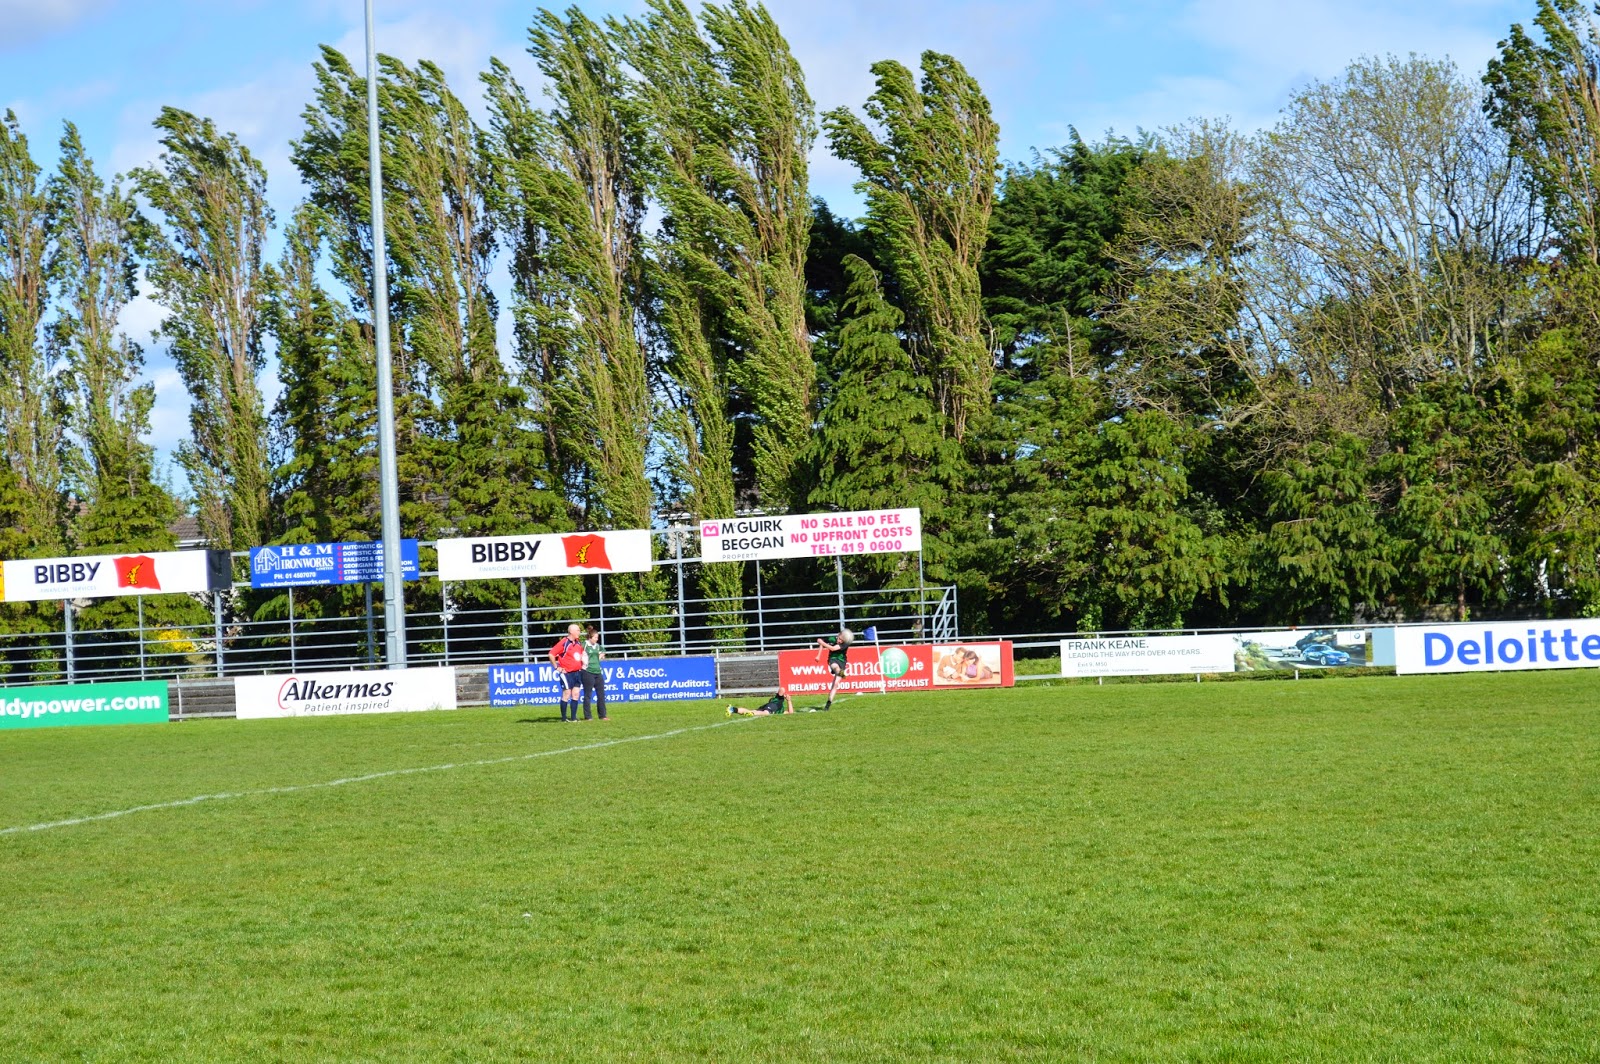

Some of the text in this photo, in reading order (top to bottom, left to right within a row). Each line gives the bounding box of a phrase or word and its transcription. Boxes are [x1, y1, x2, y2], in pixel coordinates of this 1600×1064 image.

[801, 514, 900, 529] NO SALE NO FEE
[791, 526, 913, 543] NO UPFRONT COSTS
[722, 536, 784, 551] BEGGAN
[811, 544, 836, 554] TEL:
[870, 540, 902, 551] 0600
[281, 544, 333, 557] H & M
[471, 540, 542, 563] BIBBY
[722, 552, 758, 560] PROPERTY
[281, 557, 334, 569] IRONWORKS
[34, 561, 101, 584] BIBBY
[1068, 639, 1149, 651] FRANK KEANE.
[1423, 628, 1600, 667] Deloitte
[1068, 651, 1099, 659] LEADING
[493, 667, 535, 687] Hugh
[616, 667, 626, 679] &
[627, 666, 668, 679] Assoc.
[283, 680, 394, 701] Alkermes
[495, 685, 560, 695] Accountants &
[622, 681, 669, 692] Registered
[671, 680, 712, 689] Auditors.
[788, 683, 826, 692] IRELAND'S
[888, 678, 929, 688] SPECIALIST
[304, 700, 390, 712] Patient inspired
[493, 698, 516, 706] Phone
[519, 697, 561, 705] 01-4924367
